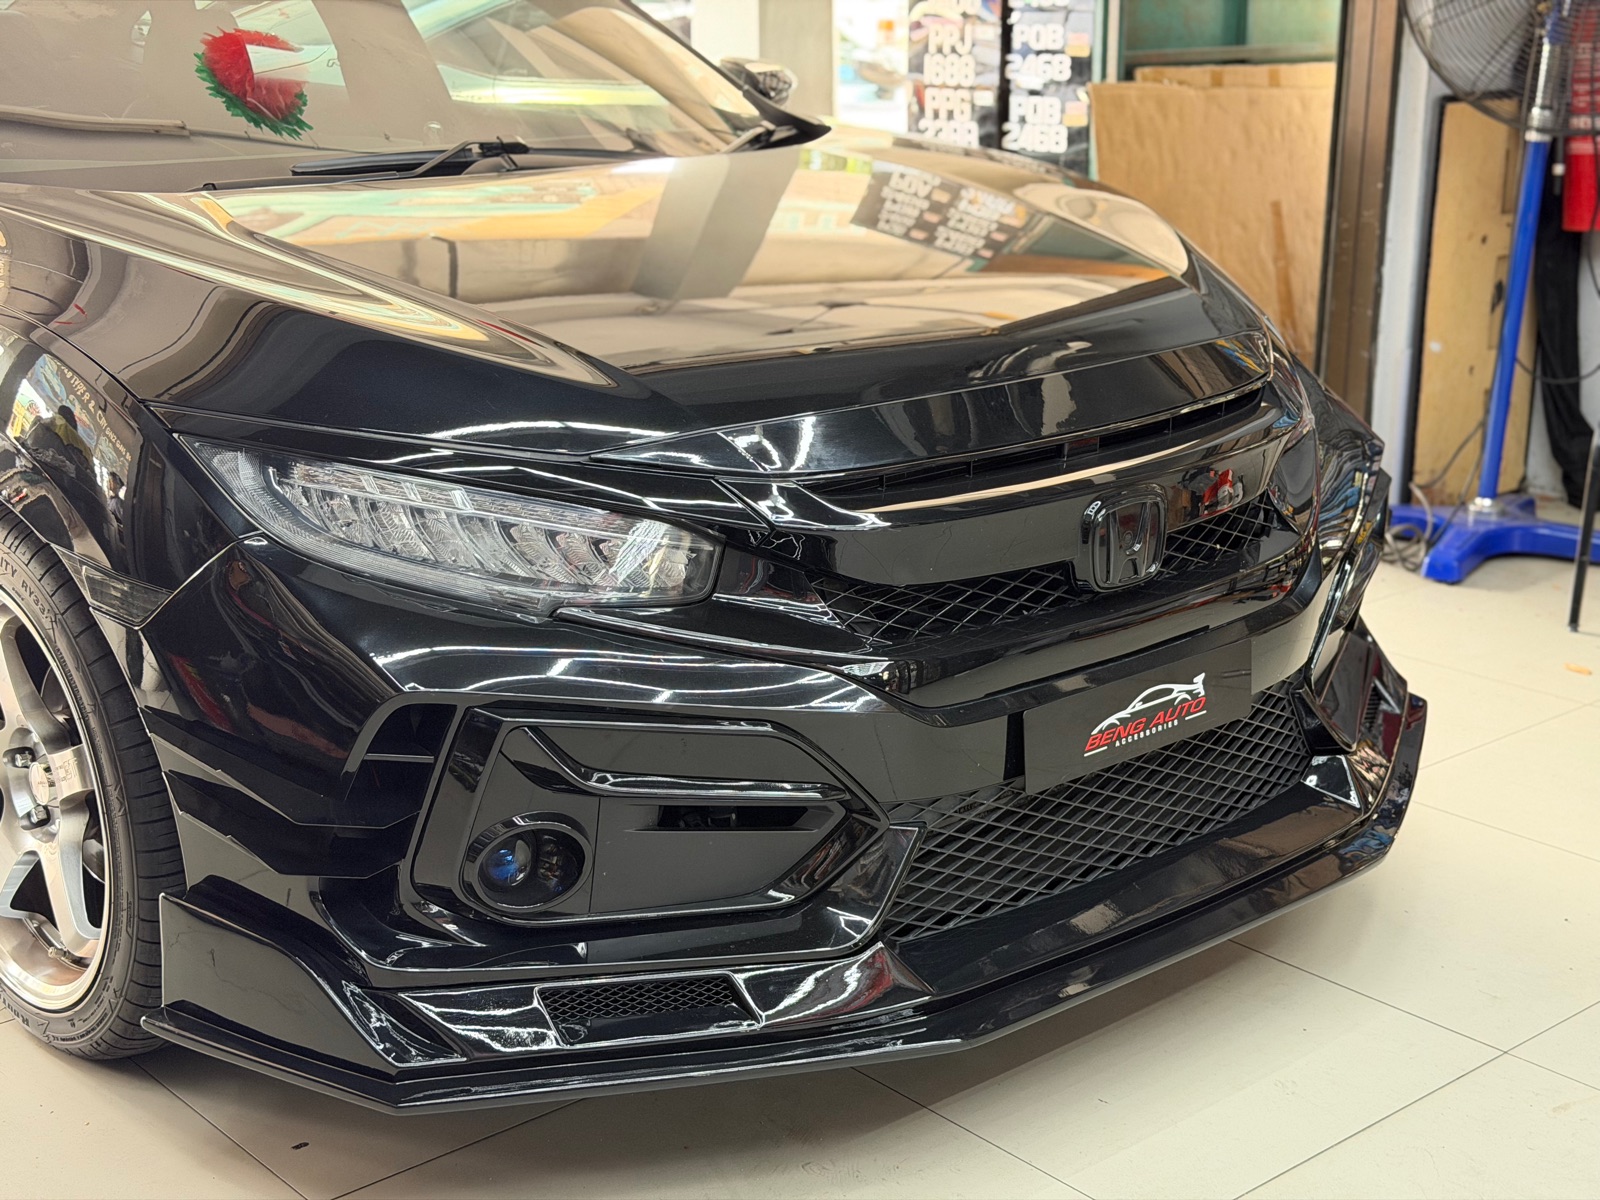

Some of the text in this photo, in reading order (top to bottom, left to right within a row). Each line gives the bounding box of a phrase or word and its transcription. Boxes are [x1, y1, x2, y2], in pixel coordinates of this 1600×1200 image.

[923, 53, 976, 87] 1688
[1002, 121, 1068, 153] 2468
[1085, 697, 1207, 751] BENG AUTO
[1115, 719, 1179, 748] ACCESSORIES
